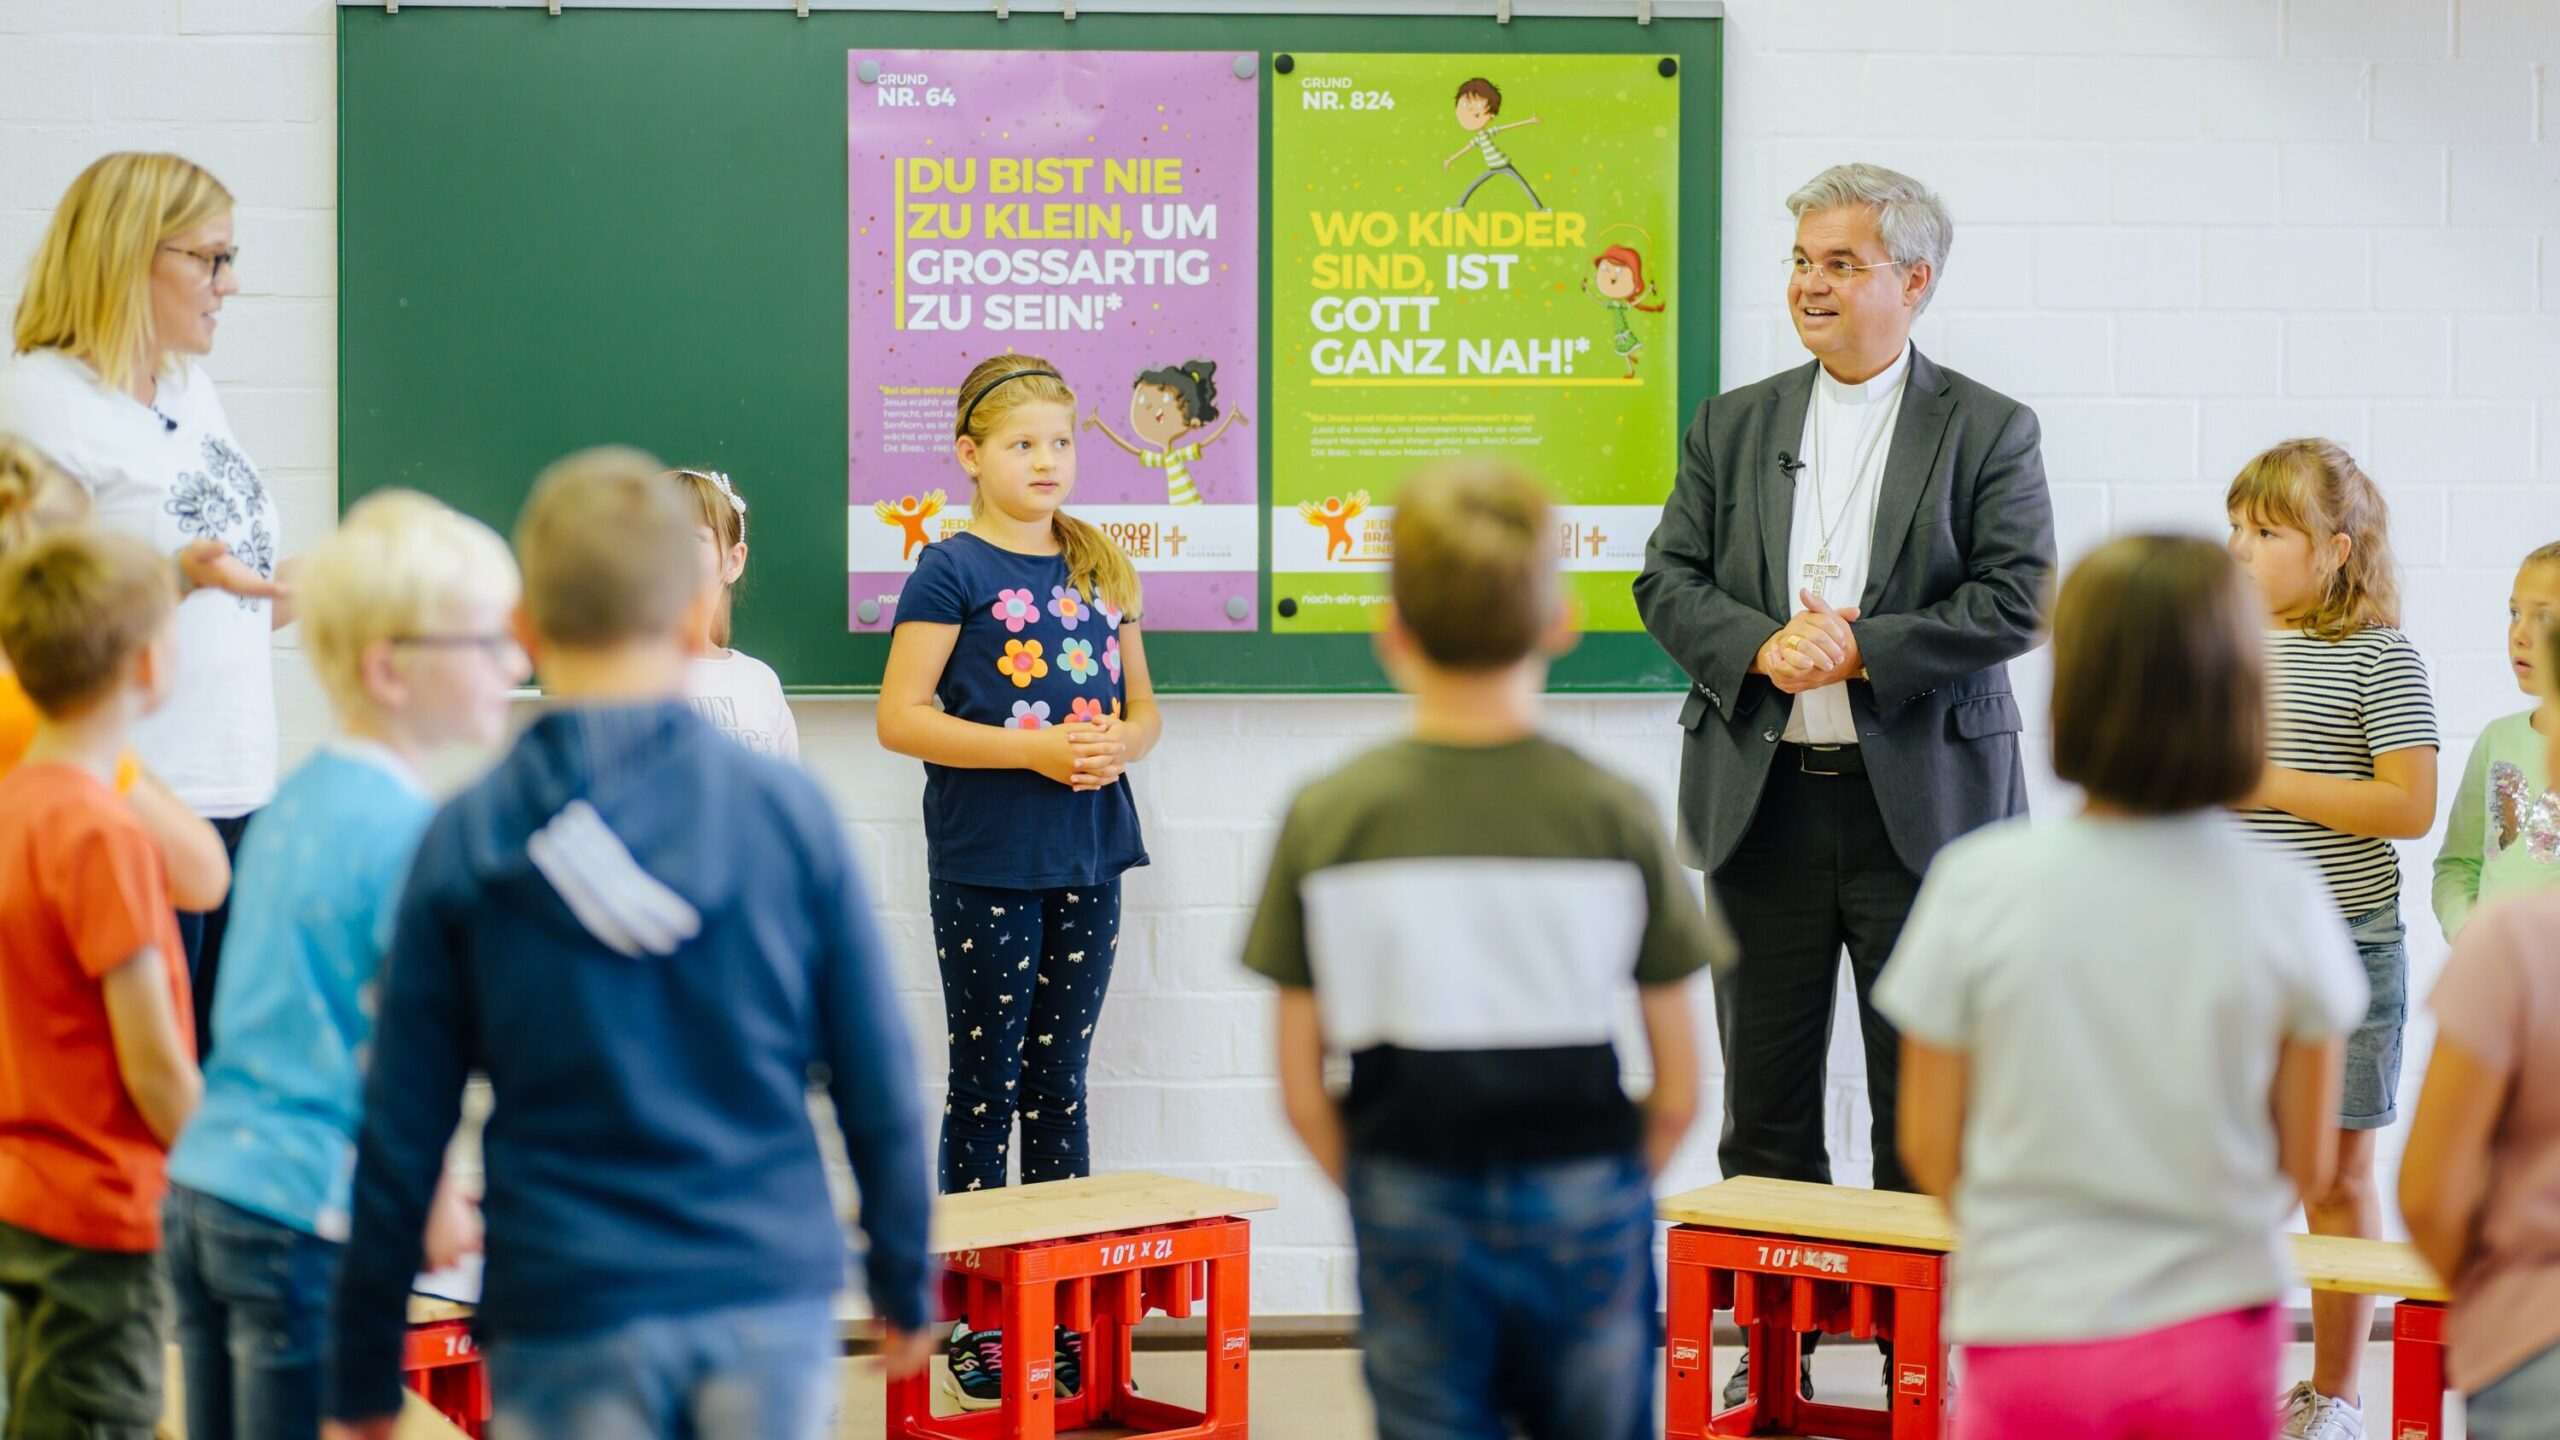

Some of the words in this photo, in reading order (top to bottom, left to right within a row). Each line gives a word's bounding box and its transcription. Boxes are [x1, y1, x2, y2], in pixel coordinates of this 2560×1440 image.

[877, 73, 928, 86] GRUND
[1302, 77, 1352, 89] GRUND
[877, 87, 920, 107] NR.
[926, 87, 956, 107] 64
[1302, 91, 1345, 110] NR.
[1350, 90, 1395, 111] 824
[908, 157, 977, 194] DU
[989, 157, 1094, 194] BIST
[1104, 158, 1183, 194] NIE
[907, 204, 972, 240] ZU
[984, 203, 1134, 245] KLEIN,
[1141, 204, 1218, 240] UM
[1310, 211, 1398, 247] WO
[1409, 211, 1586, 247] KINDER
[907, 248, 1210, 285] GROSSARTIG
[1310, 254, 1434, 294] SIND,
[1446, 254, 1519, 290] IST
[907, 294, 972, 330] ZU
[1310, 296, 1439, 332] GOTT
[1310, 338, 1446, 375] GANZ
[883, 398, 908, 407] Jesus
[908, 398, 940, 407] erzählt
[923, 409, 944, 418] wird
[926, 422, 937, 430] es
[937, 421, 948, 430] ist
[1337, 425, 1352, 434] die
[1353, 425, 1383, 434] Kinder
[1384, 426, 1397, 434] zu
[1509, 425, 1533, 434] nicht
[883, 432, 916, 441] wächst
[917, 432, 932, 441] ein
[1482, 436, 1509, 446] Reich
[1140, 1242, 1152, 1257] x
[1154, 1238, 1174, 1260] 12
